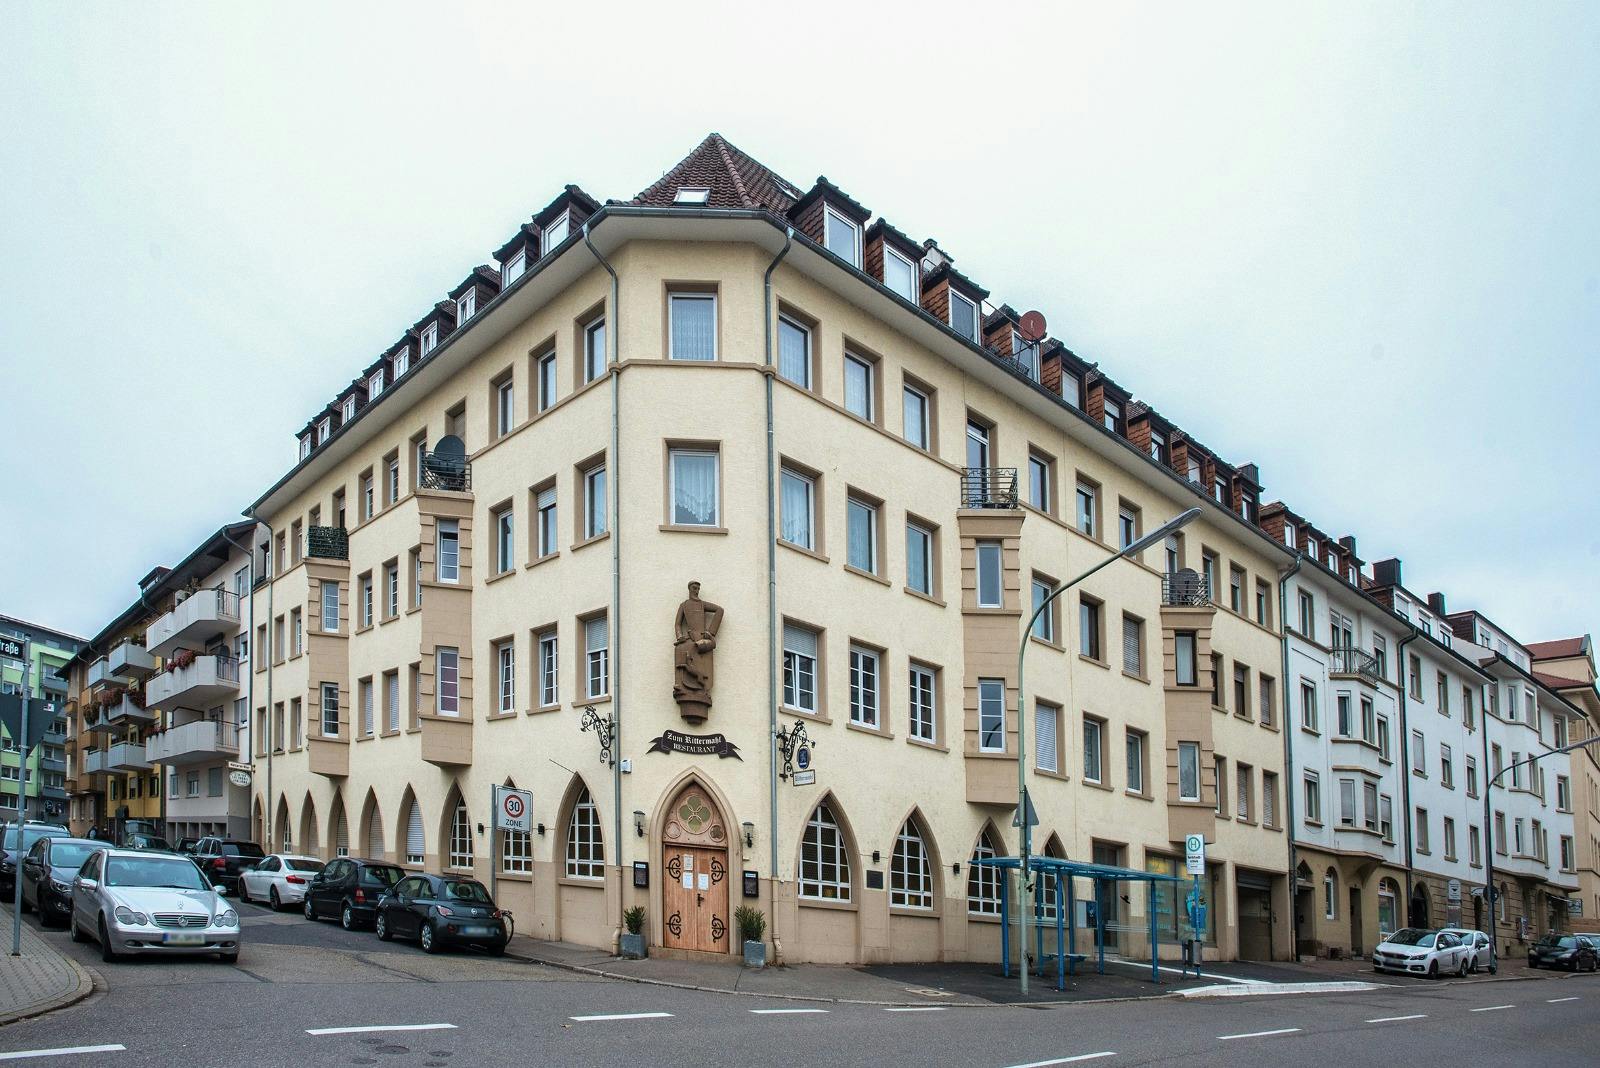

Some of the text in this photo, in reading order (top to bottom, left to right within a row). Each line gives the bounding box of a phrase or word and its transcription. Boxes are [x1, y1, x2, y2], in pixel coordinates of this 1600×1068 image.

[0, 640, 19, 655] raße
[667, 732, 722, 745] Zum Rittermahl
[673, 742, 716, 753] RESTAURANT
[508, 800, 520, 812] 30
[505, 818, 523, 828] ZONE
[1190, 840, 1197, 849] H
